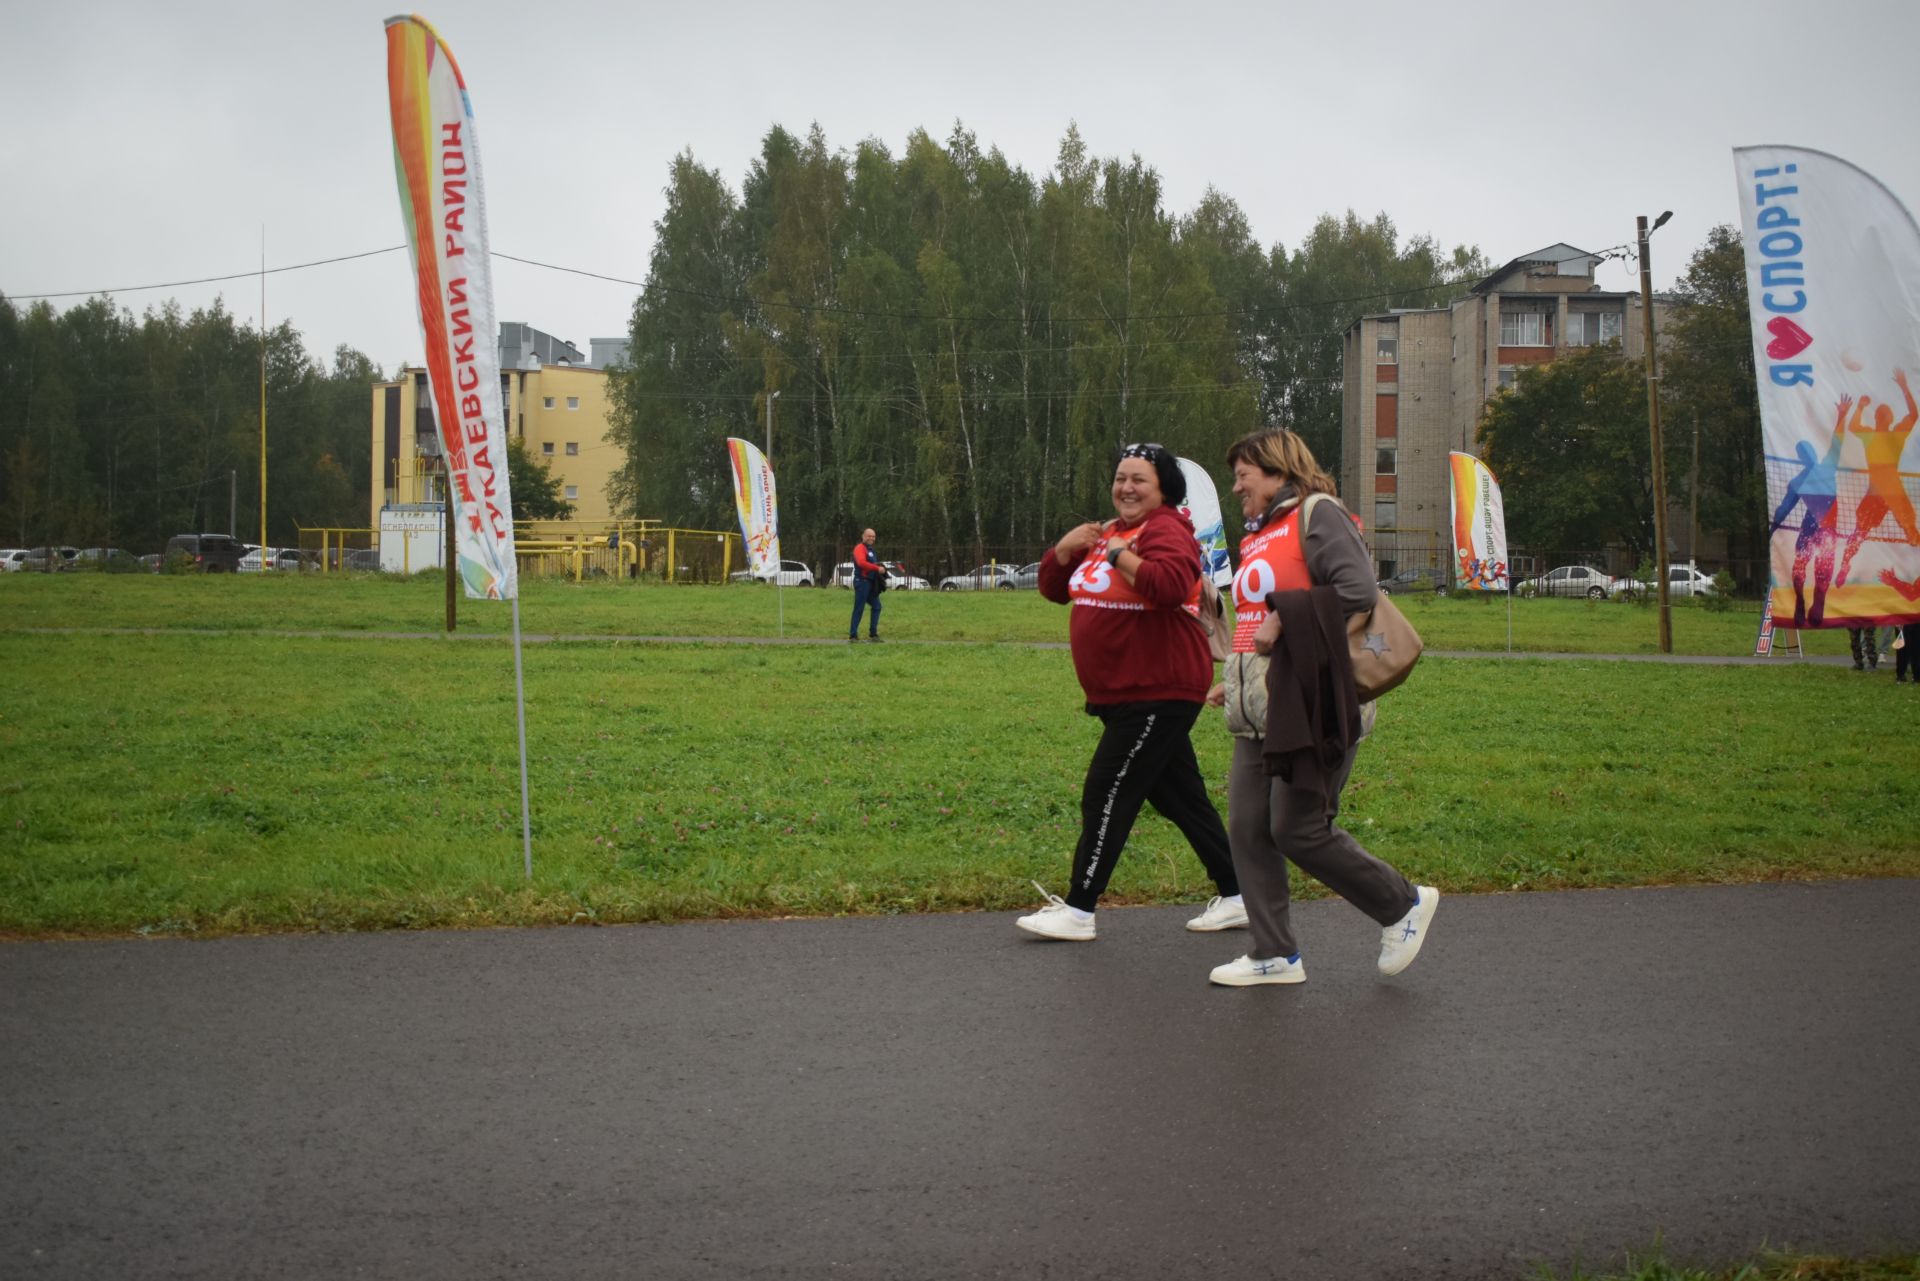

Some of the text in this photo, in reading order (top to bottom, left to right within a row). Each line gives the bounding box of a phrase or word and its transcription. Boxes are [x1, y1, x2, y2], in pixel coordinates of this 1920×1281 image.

[442, 121, 506, 545] ТУКАЕВСКИЙ РАЙОН
[1754, 163, 1814, 387] Я СПОРТ!
[1086, 855, 1099, 877] Black
